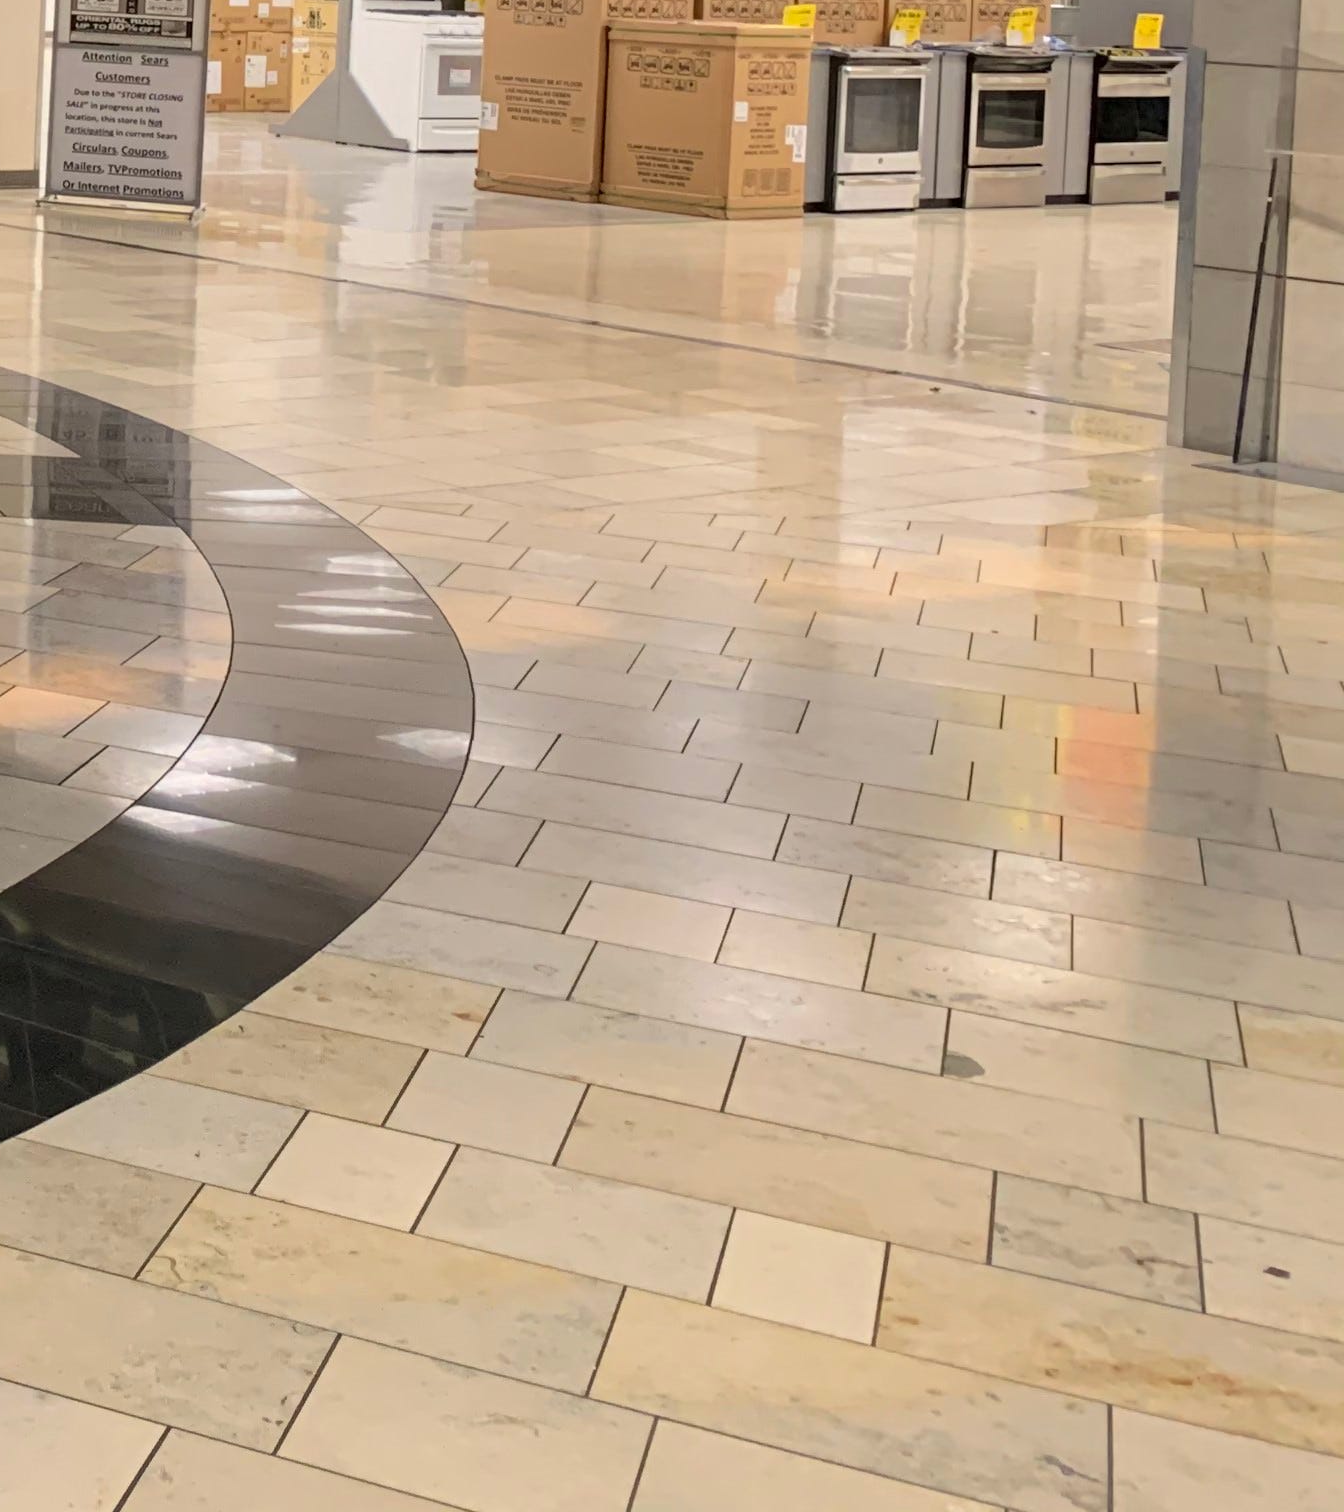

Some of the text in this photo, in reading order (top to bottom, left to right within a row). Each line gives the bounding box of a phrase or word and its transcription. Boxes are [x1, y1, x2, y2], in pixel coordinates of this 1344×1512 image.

[76, 15, 127, 24] ORIENTAL
[81, 51, 169, 66] Attention Sears
[95, 71, 150, 85] Customers
[74, 88, 90, 96] Due
[91, 89, 101, 97] to
[102, 89, 115, 97] the
[148, 93, 183, 102] CLOSING
[90, 101, 98, 109] in
[99, 103, 133, 112] progress
[135, 104, 143, 112] at
[145, 105, 160, 114] this
[65, 112, 99, 123] location,
[101, 114, 116, 123] this
[117, 116, 138, 125] store
[115, 129, 124, 137] in
[124, 129, 154, 138] current
[156, 131, 178, 140] Sears
[63, 161, 104, 174] Mailers,
[62, 180, 184, 199] Or Internet Promotions
